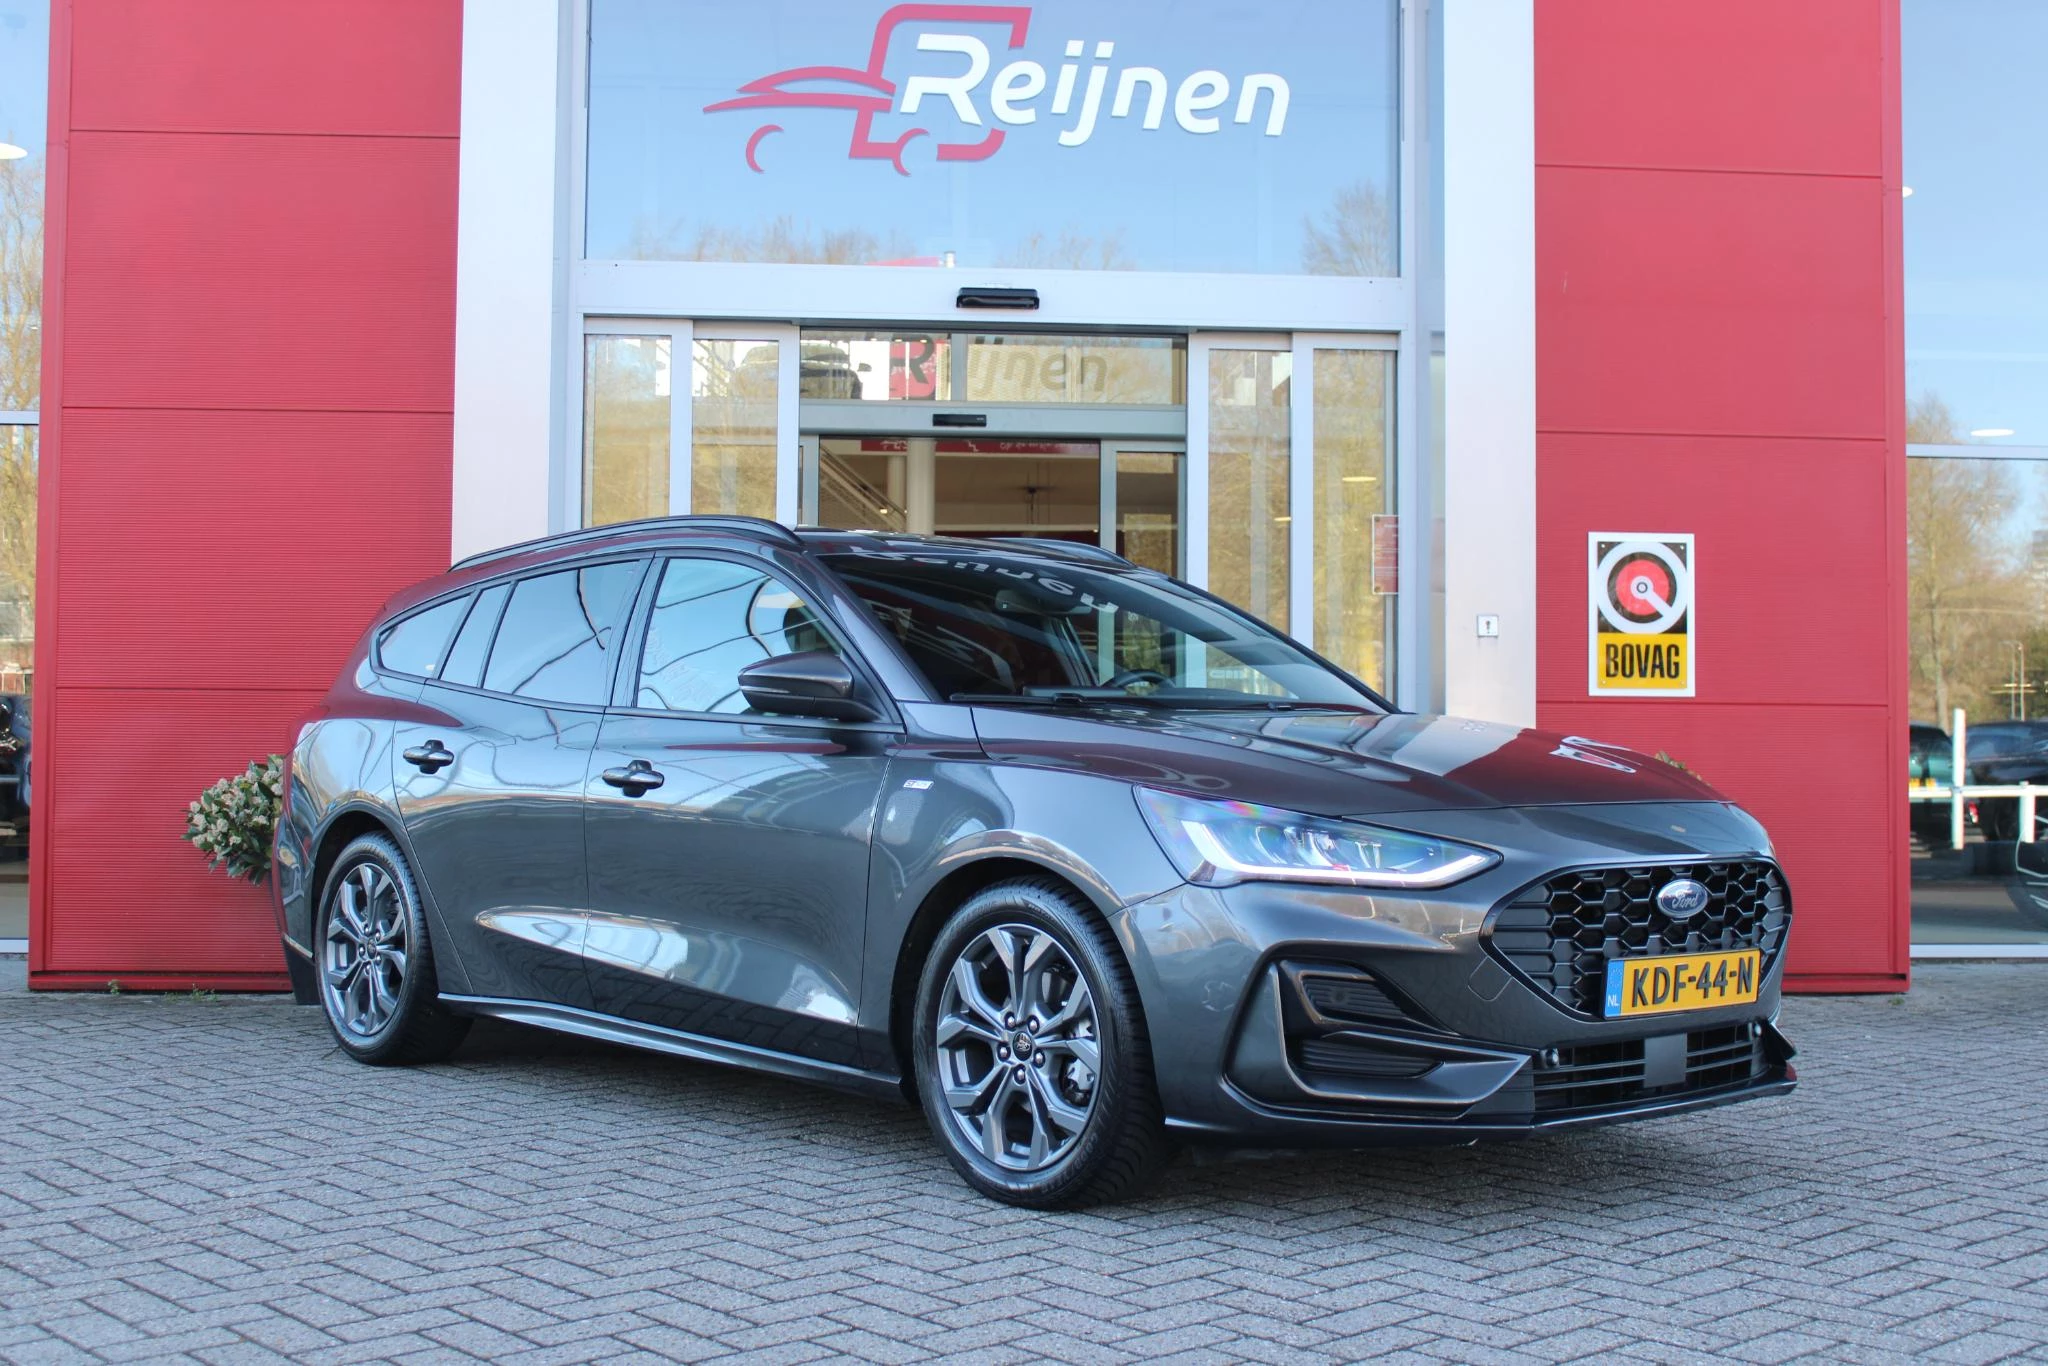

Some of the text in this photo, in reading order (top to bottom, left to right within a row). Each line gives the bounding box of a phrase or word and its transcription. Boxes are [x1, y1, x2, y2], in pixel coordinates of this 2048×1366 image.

[900, 33, 1291, 147] Reijnen
[1605, 643, 1680, 679] BOVAG
[1671, 889, 1699, 909] Ford
[1631, 956, 1754, 1008] KDF-44-N
[1607, 994, 1620, 1007] NL
